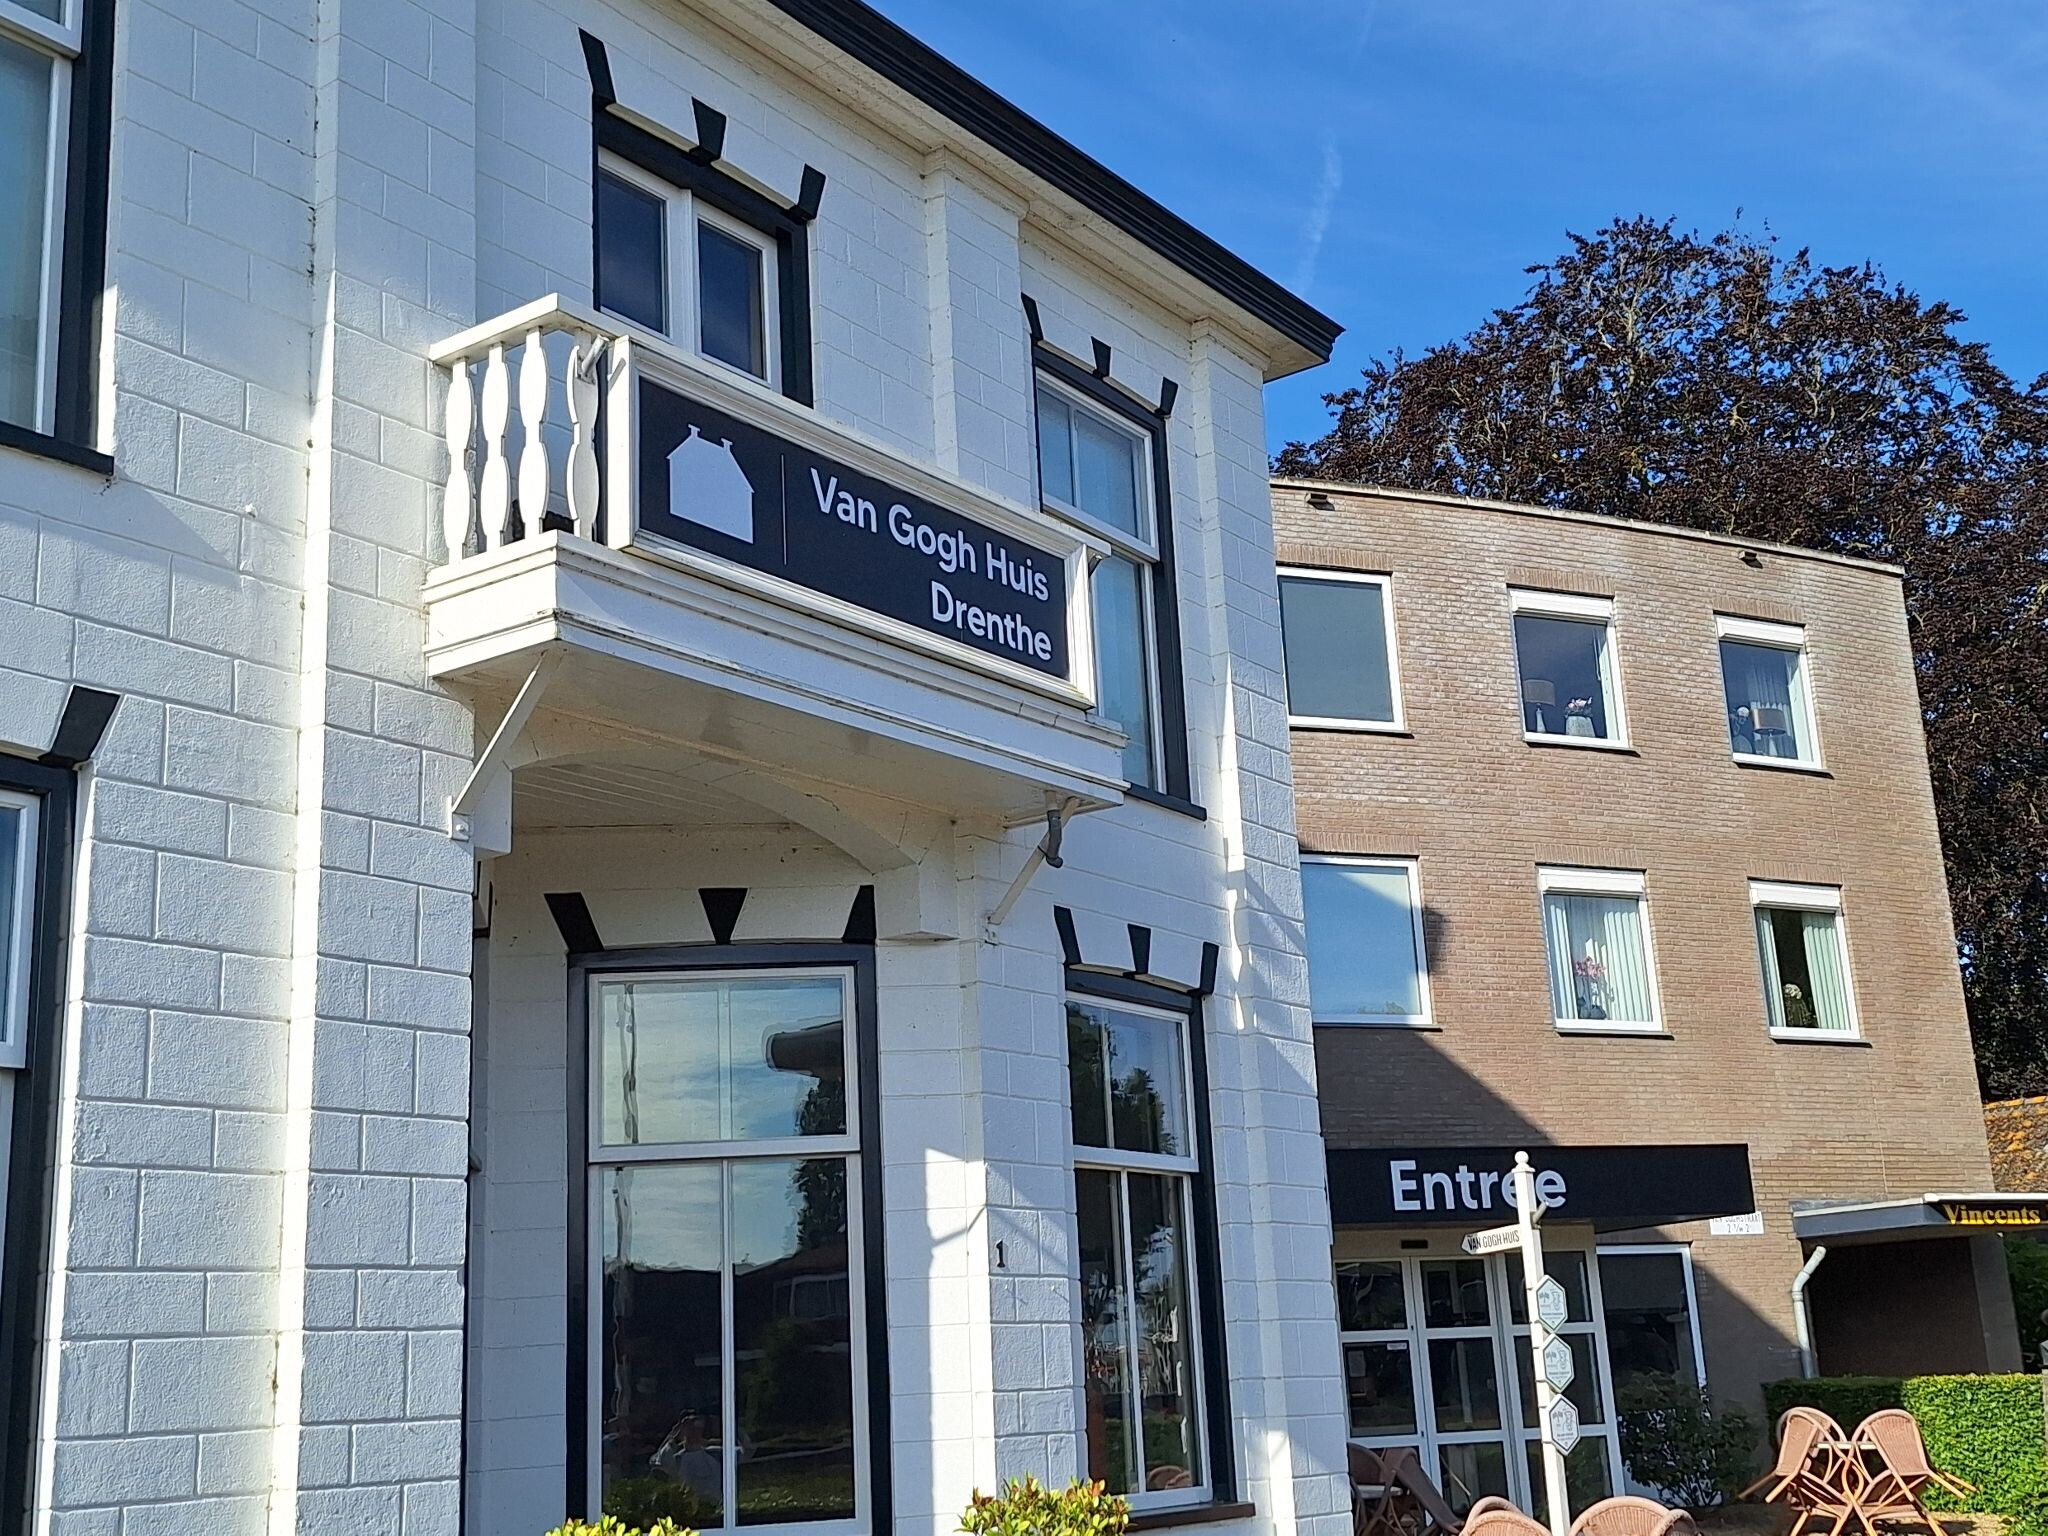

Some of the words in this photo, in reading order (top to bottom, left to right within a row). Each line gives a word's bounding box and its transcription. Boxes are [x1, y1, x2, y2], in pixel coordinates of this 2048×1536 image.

[810, 467, 878, 533] Van
[889, 504, 976, 574] Gogh
[986, 542, 1050, 601] Huis
[931, 581, 1052, 661] Drenthe
[1942, 1204, 2041, 1225] Vincents
[996, 1240, 1005, 1268] 1
[1467, 1236, 1482, 1251] VAN
[1482, 1233, 1502, 1248] GOGH
[1502, 1229, 1520, 1244] HUIS
